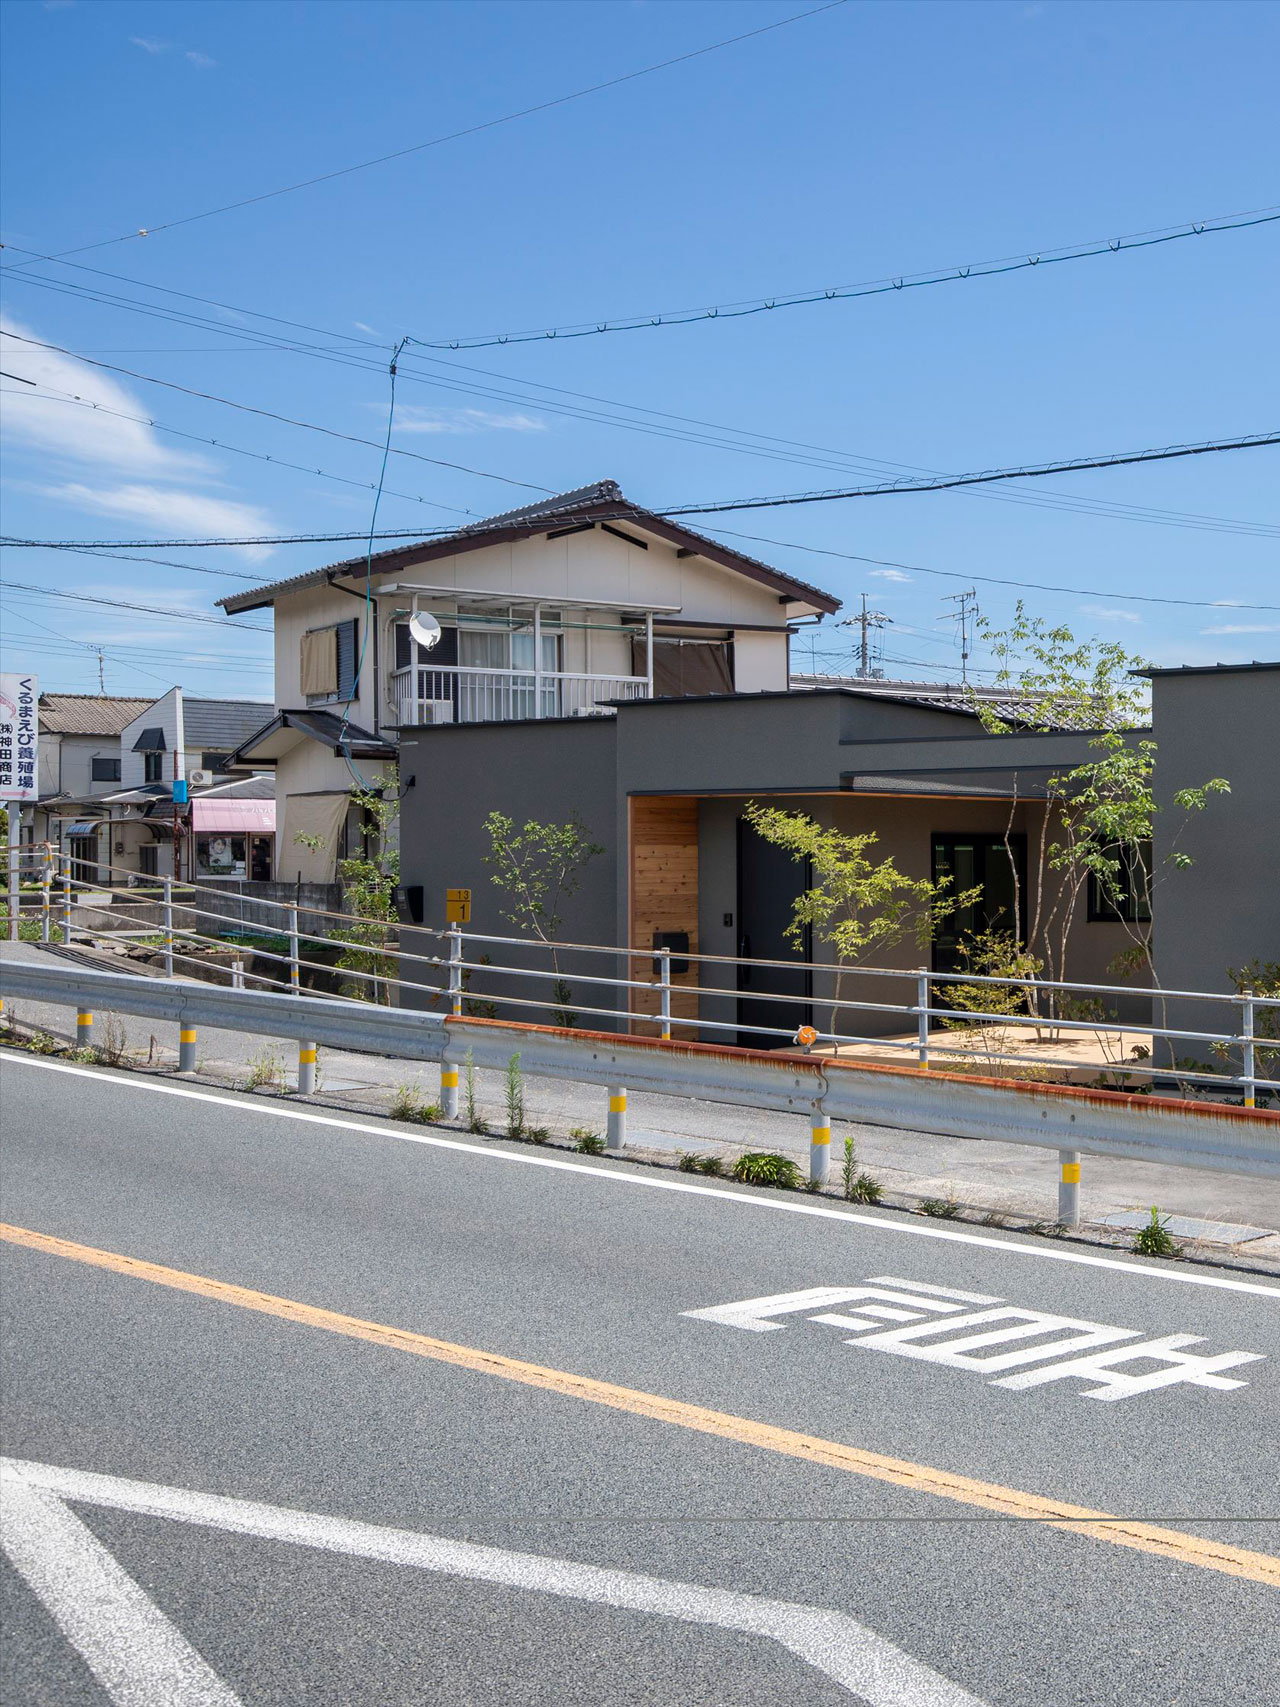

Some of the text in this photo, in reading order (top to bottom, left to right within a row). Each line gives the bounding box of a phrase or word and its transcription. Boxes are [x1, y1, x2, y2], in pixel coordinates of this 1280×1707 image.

[17, 678, 35, 788] くるまえび養殖場
[458, 890, 469, 900] 13
[459, 904, 466, 920] 1
